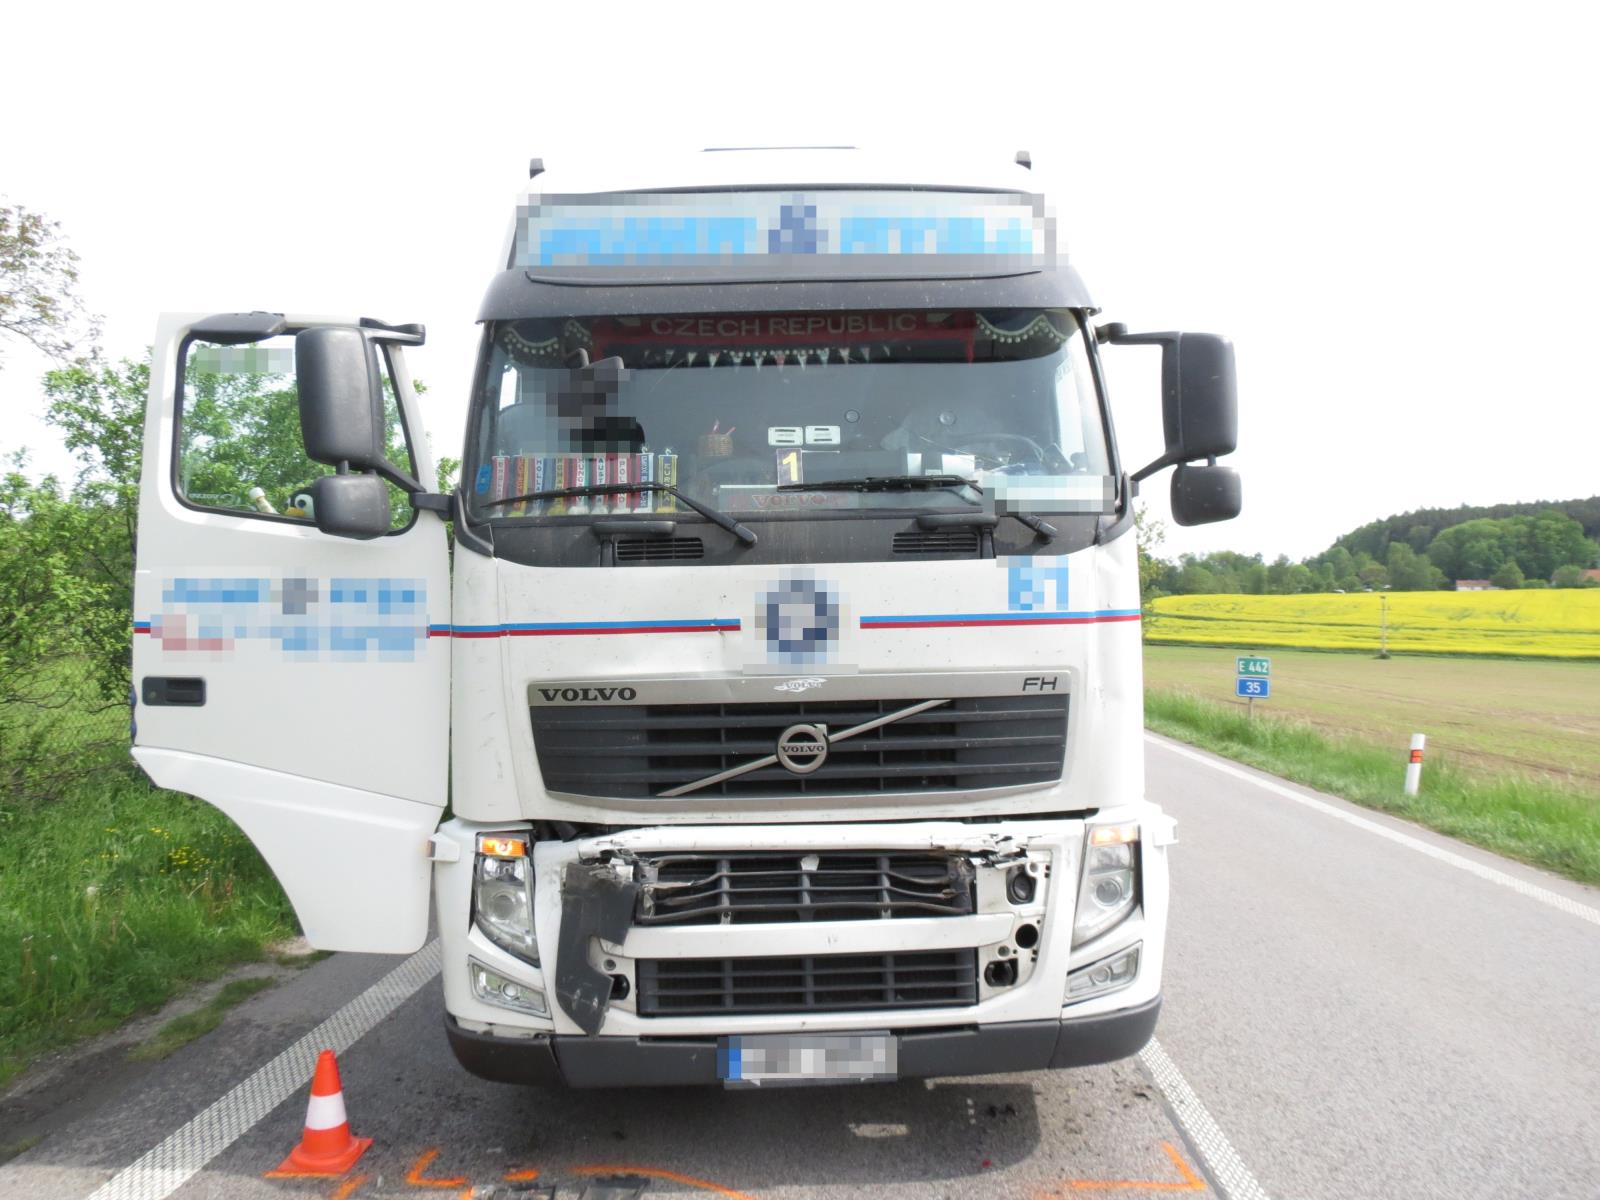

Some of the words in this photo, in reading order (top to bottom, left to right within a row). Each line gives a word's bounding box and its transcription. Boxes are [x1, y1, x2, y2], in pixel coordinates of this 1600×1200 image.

[651, 317, 760, 337] CZECH
[768, 314, 917, 335] REPUBLIC
[782, 451, 799, 482] 1
[1239, 661, 1245, 672] E
[1248, 661, 1268, 673] 442
[784, 681, 822, 689] VOLVO
[1022, 676, 1058, 691] FH
[1246, 681, 1261, 693] 35
[537, 687, 637, 702] VOLVO
[781, 745, 825, 753] VOLVO
